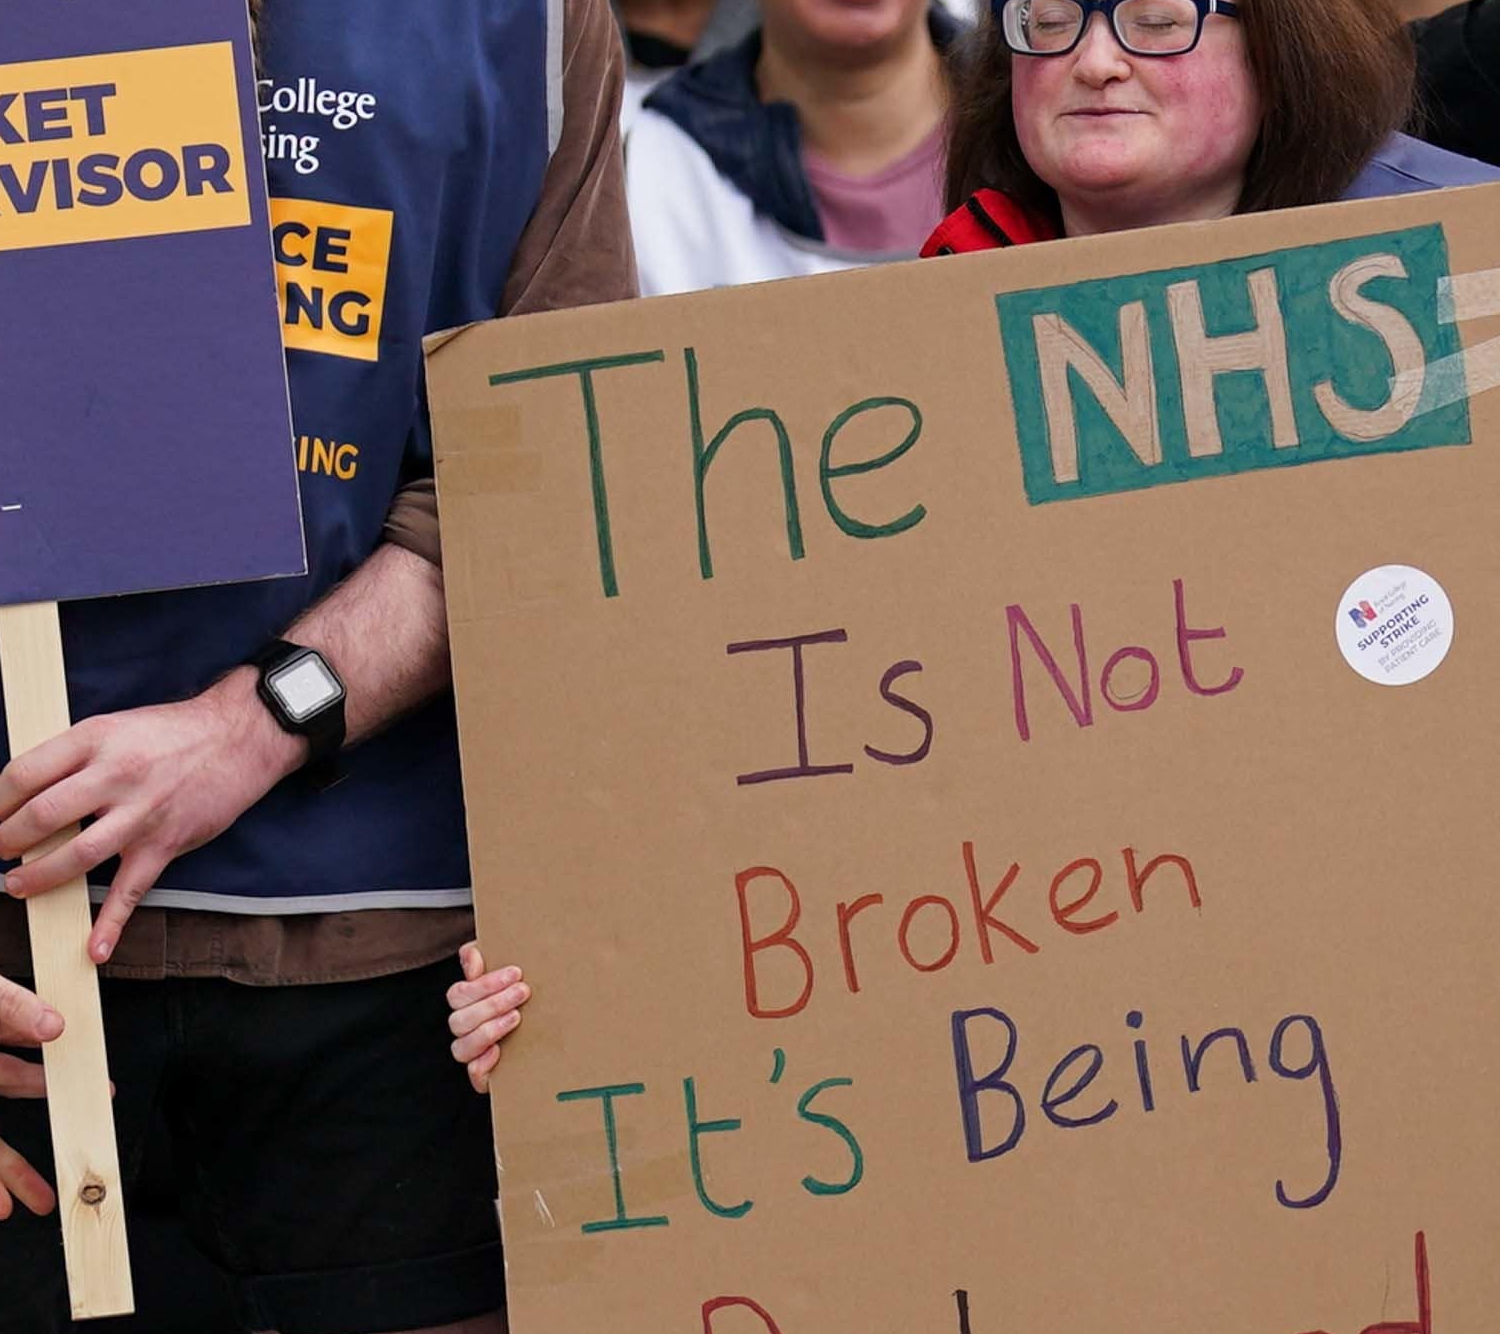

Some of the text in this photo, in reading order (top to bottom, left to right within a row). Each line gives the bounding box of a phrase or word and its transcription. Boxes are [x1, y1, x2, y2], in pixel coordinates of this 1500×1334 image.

[257, 77, 377, 130] College
[488, 252, 1429, 599] The NHS
[725, 577, 1245, 787] Is Not
[1356, 593, 1430, 652] SUPPORTING
[1379, 614, 1421, 649] STRIKE
[734, 840, 1203, 1021] Broken
[554, 1006, 1344, 1235] It's Being
